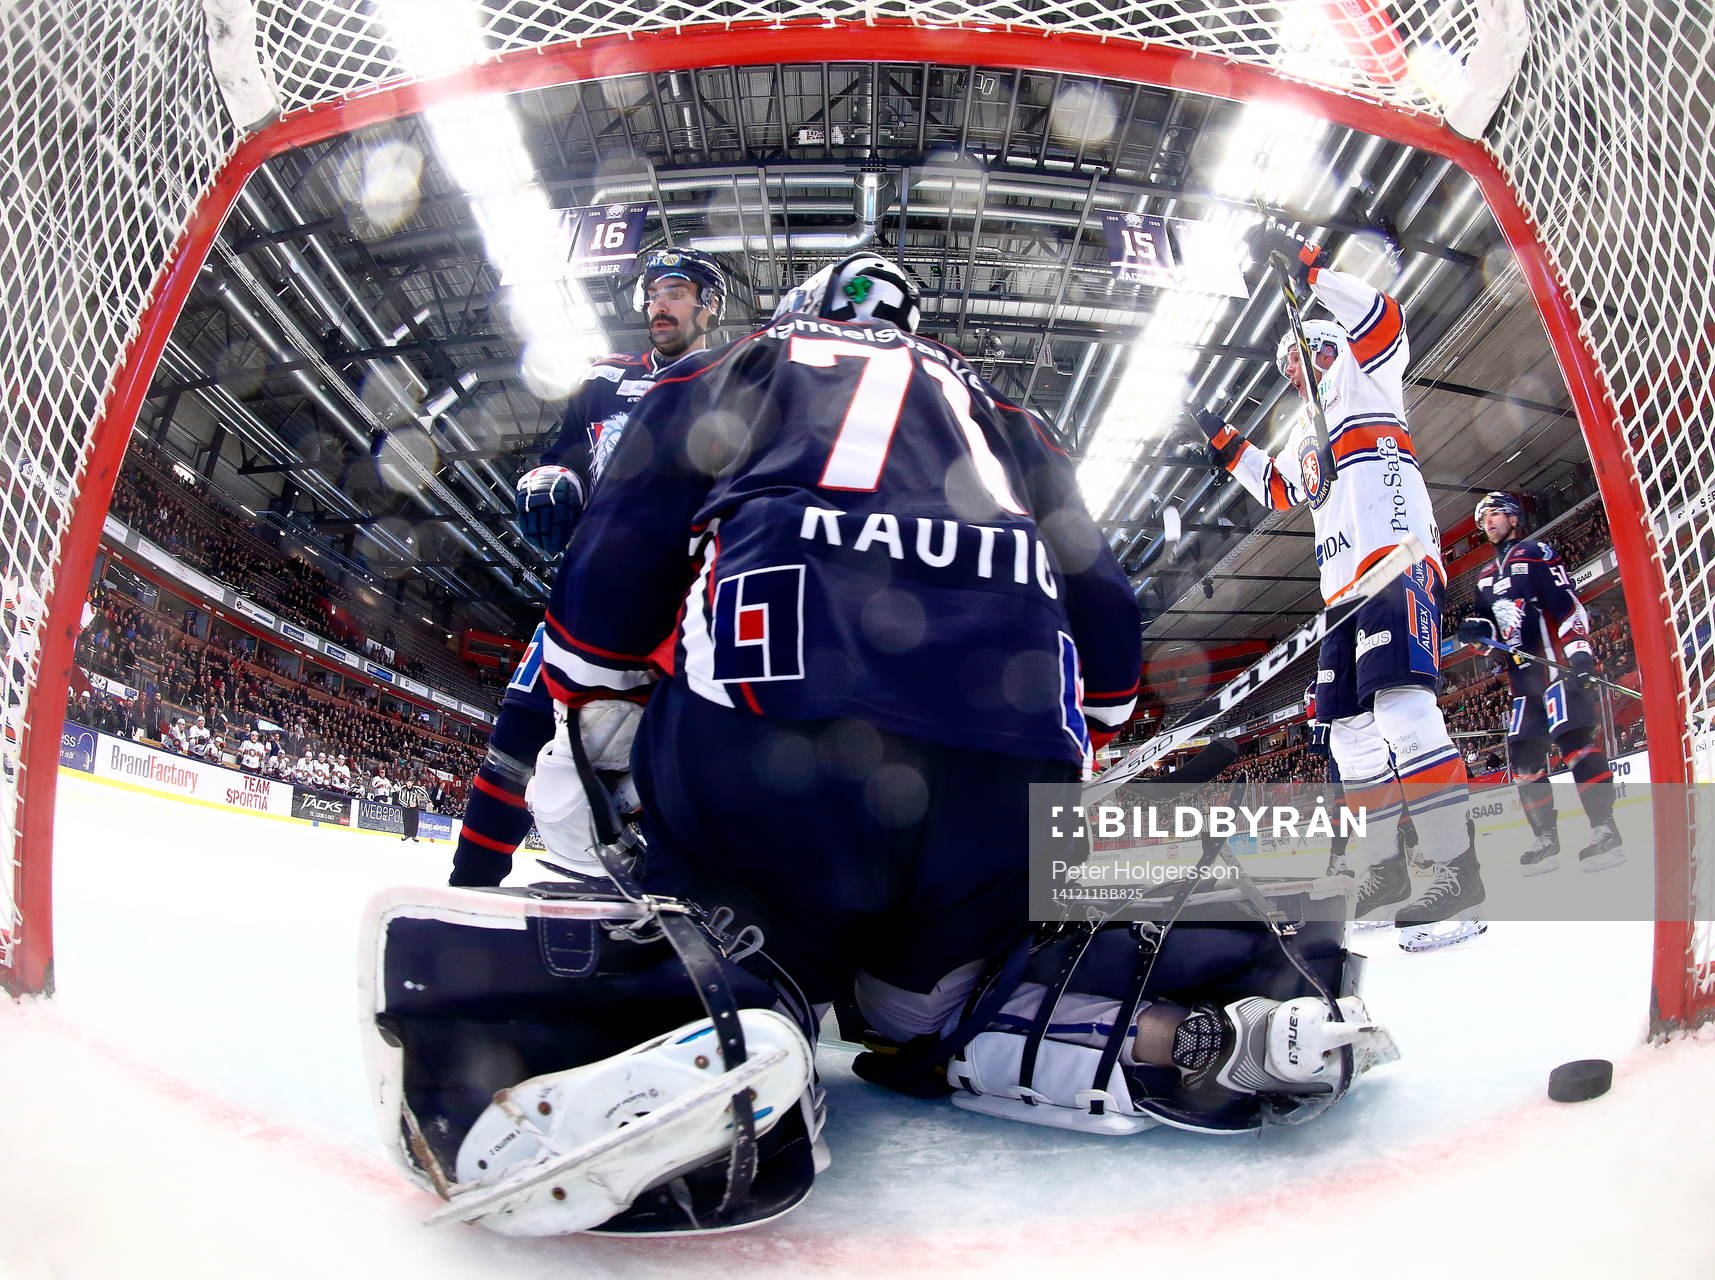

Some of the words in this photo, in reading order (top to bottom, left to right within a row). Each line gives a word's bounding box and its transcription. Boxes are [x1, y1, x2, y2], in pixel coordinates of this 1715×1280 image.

[590, 221, 628, 250] 16
[1121, 229, 1157, 259] 15
[1383, 436, 1408, 533] Pro-Safe
[1549, 565, 1570, 586] 51
[1576, 571, 1592, 585] SAAB
[1417, 608, 1430, 649] ALWEX
[1127, 735, 1173, 774] 500
[111, 744, 199, 794] BrandFactory
[243, 775, 271, 796] TEAM
[226, 788, 268, 811] SPORTIA
[300, 793, 344, 813] TACKS
[1472, 803, 1503, 819] SAAB
